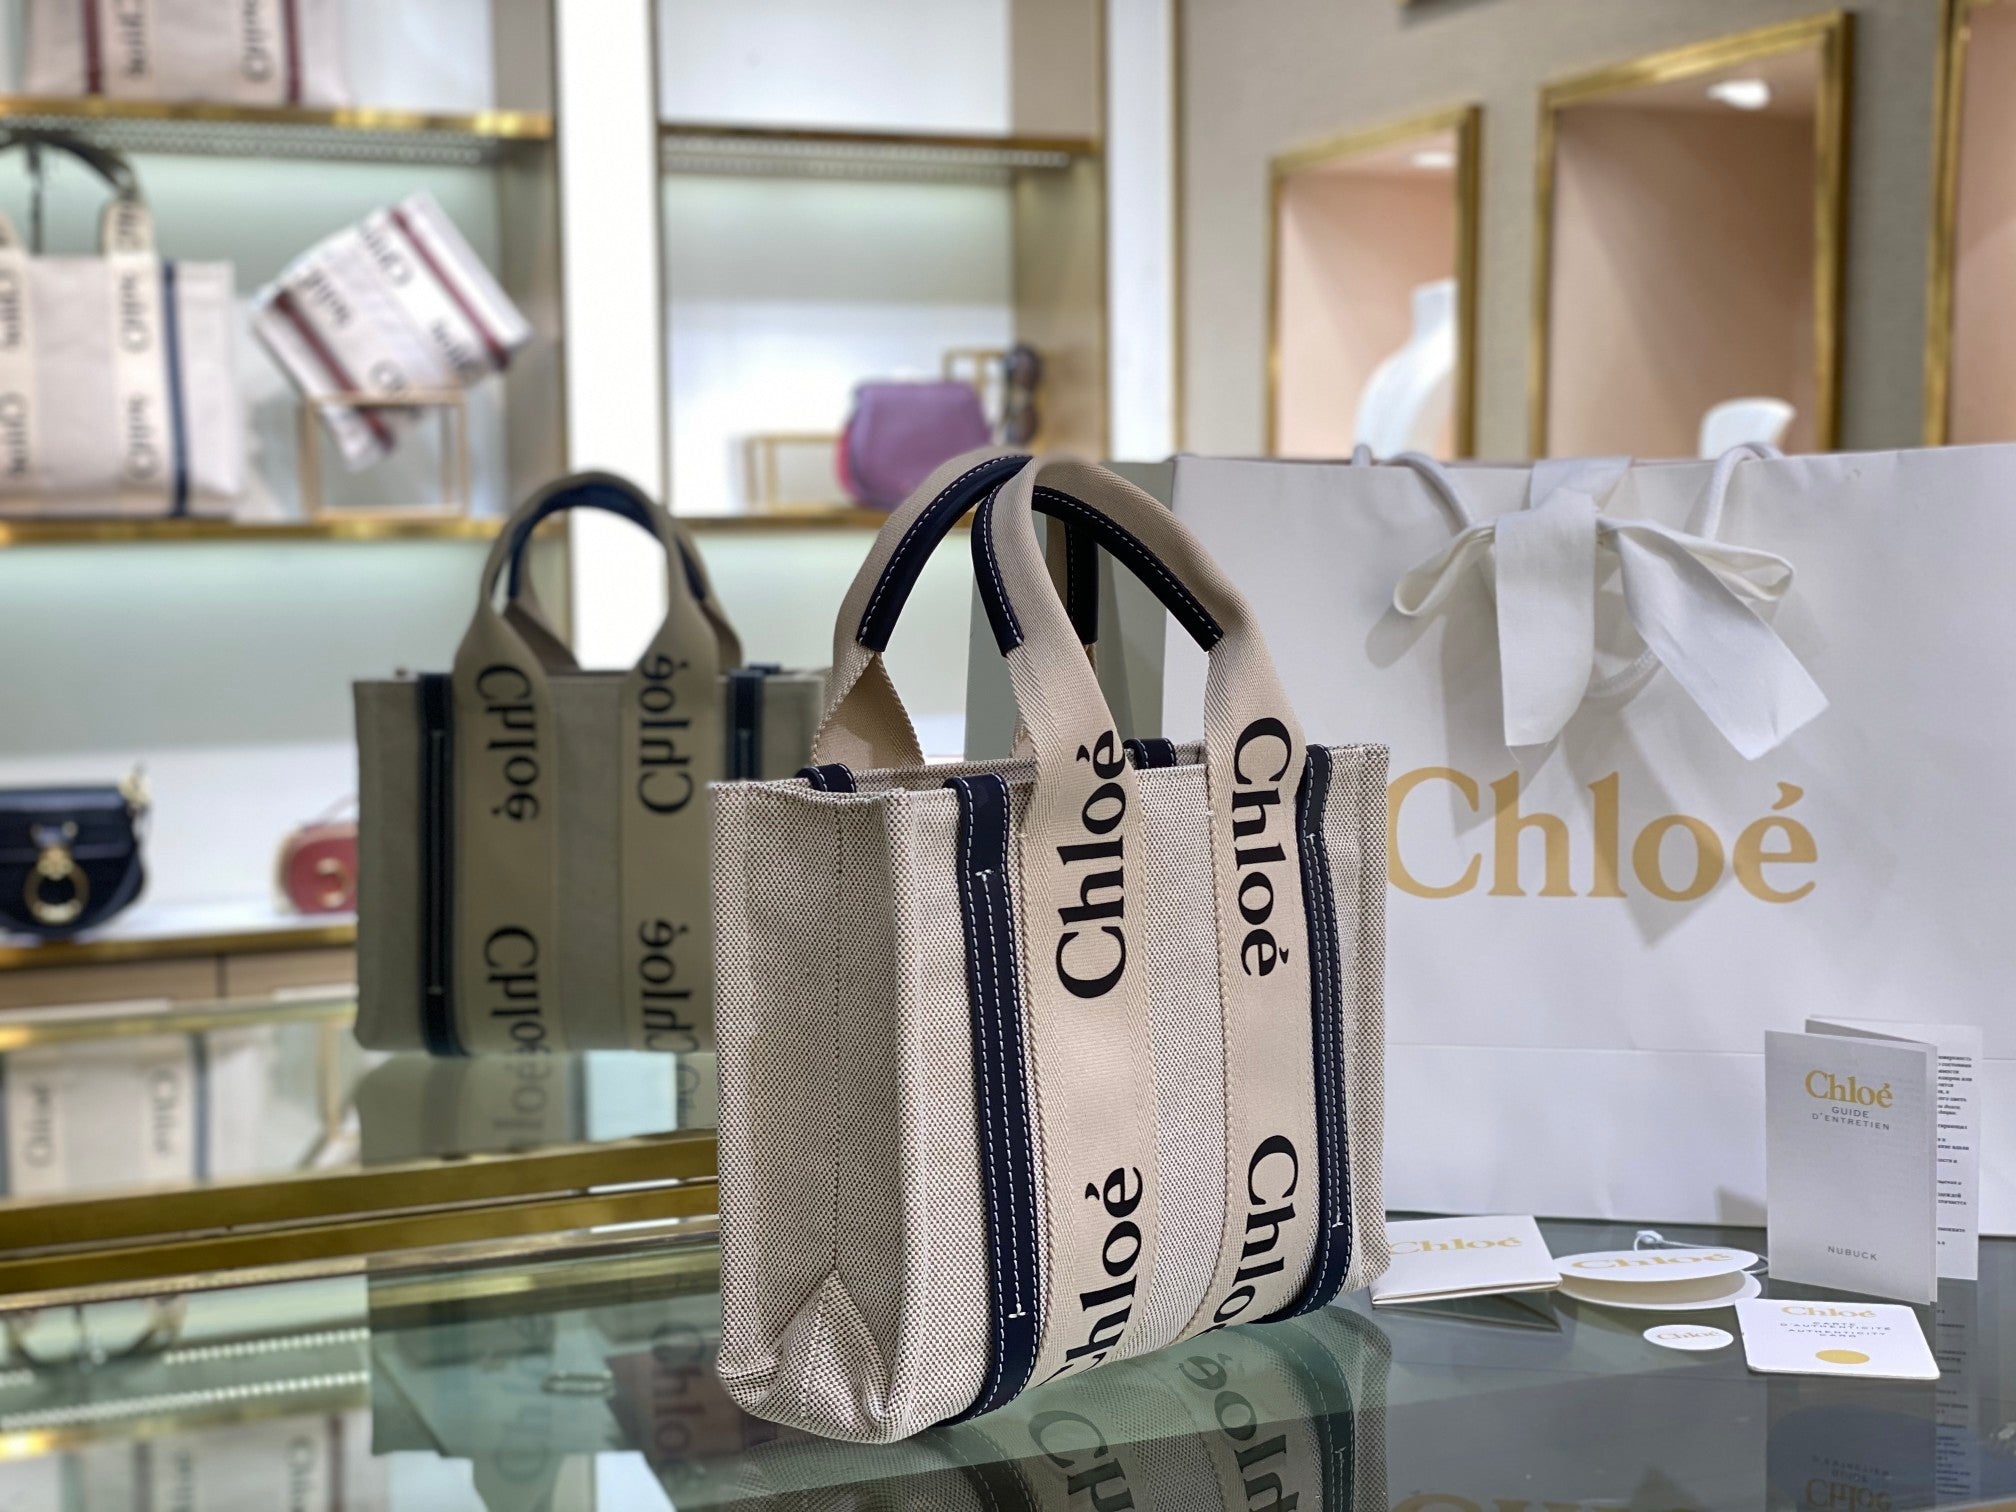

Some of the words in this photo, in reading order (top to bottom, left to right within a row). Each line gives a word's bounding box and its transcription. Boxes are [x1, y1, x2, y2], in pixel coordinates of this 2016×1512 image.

[1055, 729, 1128, 999] Chloé
[1231, 716, 1291, 977] Chloé
[1386, 765, 1818, 905] Chloé
[1804, 1068, 1894, 1109] Chloé
[1811, 1111, 1890, 1131] D'ENTRETIEN
[1831, 1105, 1870, 1119] GUIDE
[1183, 1134, 1299, 1341] Chlo
[1827, 1245, 1878, 1261] NUBUCK
